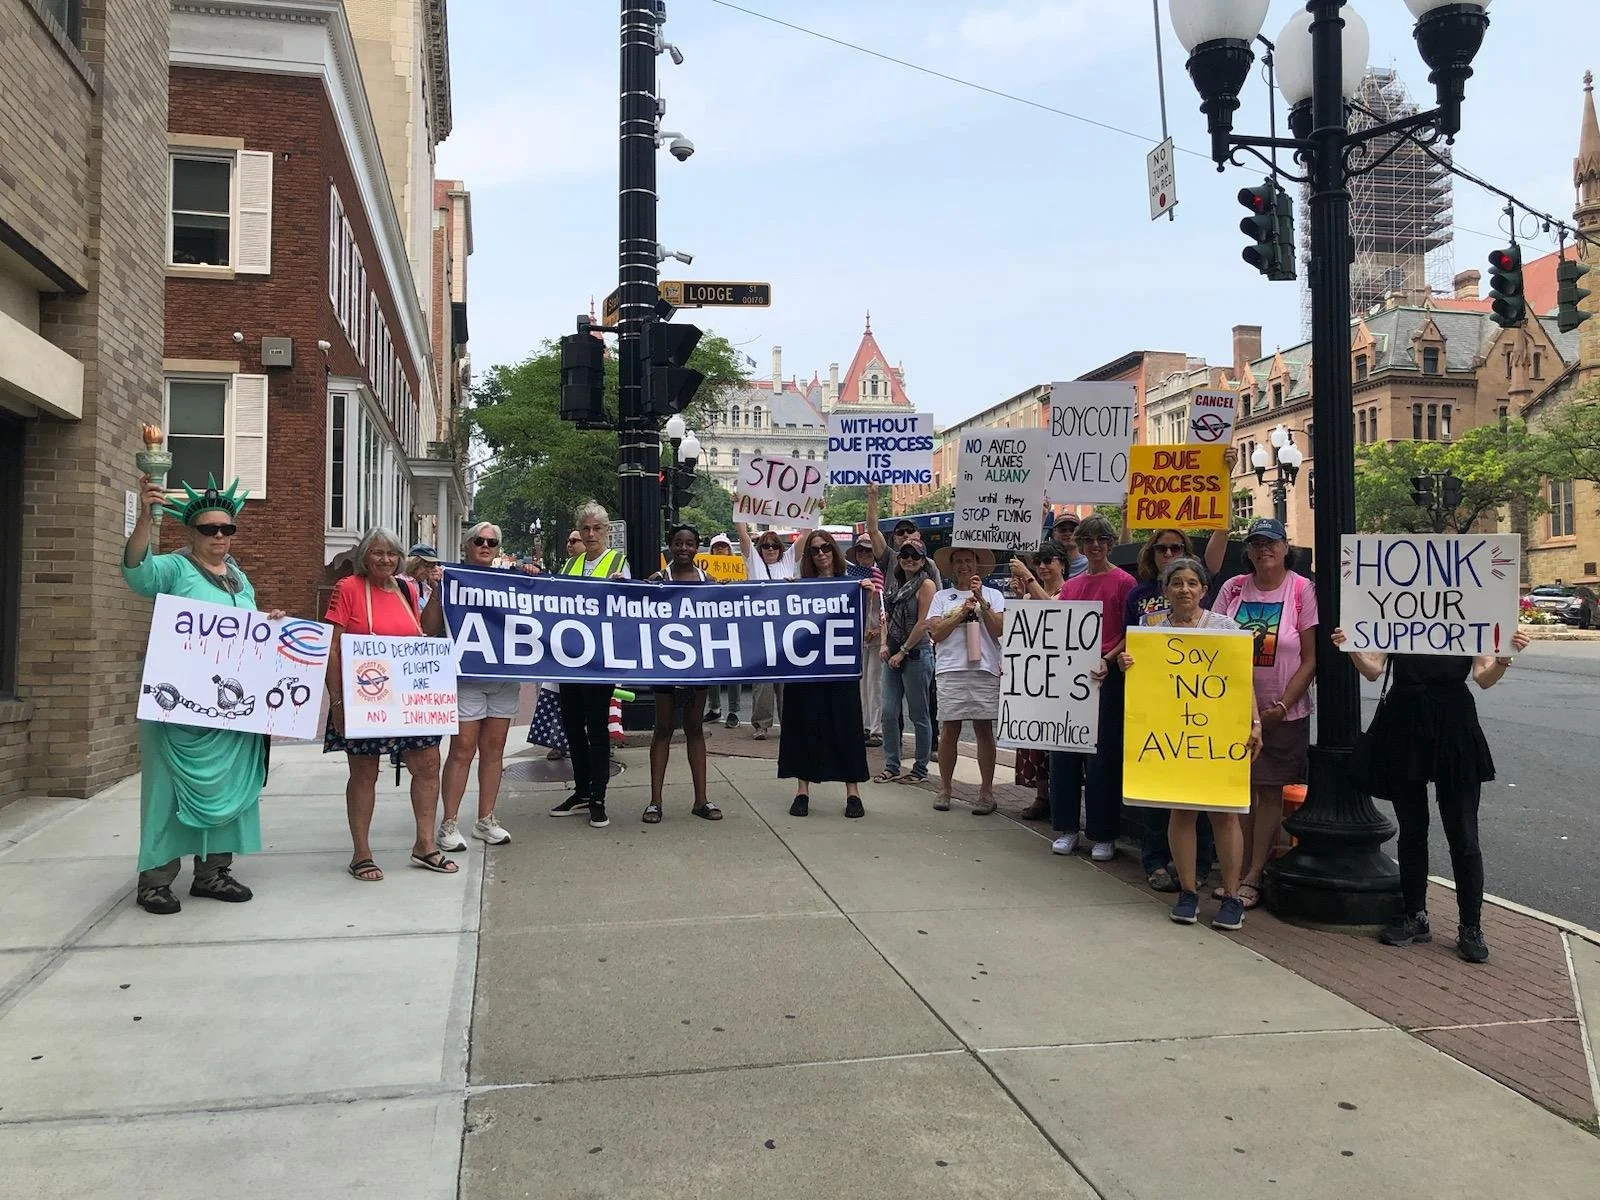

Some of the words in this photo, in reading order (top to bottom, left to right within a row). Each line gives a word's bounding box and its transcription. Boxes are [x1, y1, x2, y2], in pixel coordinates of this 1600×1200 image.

[1153, 148, 1166, 166] NO
[1153, 162, 1168, 179] TURN
[1161, 174, 1172, 190] RED
[689, 286, 733, 301] LODGE
[742, 296, 764, 304] 00170
[1195, 394, 1234, 409] CANCEL
[841, 418, 918, 434] WITHOUT
[1052, 406, 1132, 437] BOYCOTT
[829, 437, 861, 452] DUE
[865, 436, 933, 451] PROCESS
[965, 439, 982, 454] NO
[988, 440, 1027, 454] AVELO
[867, 454, 891, 468] ITS
[981, 455, 1023, 468] PLANES
[1049, 452, 1127, 482] AVELO
[1153, 450, 1201, 470] DUE
[746, 458, 821, 494] STOP
[830, 470, 932, 485] KIDNAPPING
[964, 470, 973, 481] in
[985, 469, 1031, 484] ALBANY
[1129, 472, 1221, 495] PROCESS
[739, 495, 817, 520] AVELO!!
[979, 493, 998, 504] until
[1005, 494, 1025, 509] they
[1136, 497, 1171, 520] FOR
[1175, 495, 1224, 520] ALL
[962, 507, 990, 521] STOP
[997, 510, 1032, 523] FLYING
[989, 523, 1000, 532] to
[955, 530, 1021, 543] CONCENTRATION
[1356, 540, 1487, 588] HONK
[450, 579, 599, 615] Immigrants
[606, 594, 673, 619] Make
[678, 595, 780, 619] America
[787, 593, 855, 616] Great.
[1368, 590, 1466, 620] YOUR
[175, 611, 271, 643] avelo
[1006, 608, 1100, 651] AVELO
[455, 612, 743, 670] ABOLISH
[763, 619, 856, 667] ICE
[1354, 621, 1500, 653] SUPPORT!
[353, 640, 387, 657] AVELO
[391, 641, 451, 658] DEPORTATION
[1166, 637, 1219, 671] Say
[403, 660, 440, 676] FLIGHTS
[413, 677, 430, 690] ARE
[1003, 653, 1090, 701] ICE's
[402, 692, 456, 707] UNAMERICAN
[367, 709, 388, 722] AND
[402, 709, 456, 725] INHUMANE
[999, 699, 1090, 746] Accomplice
[1181, 702, 1209, 727] to
